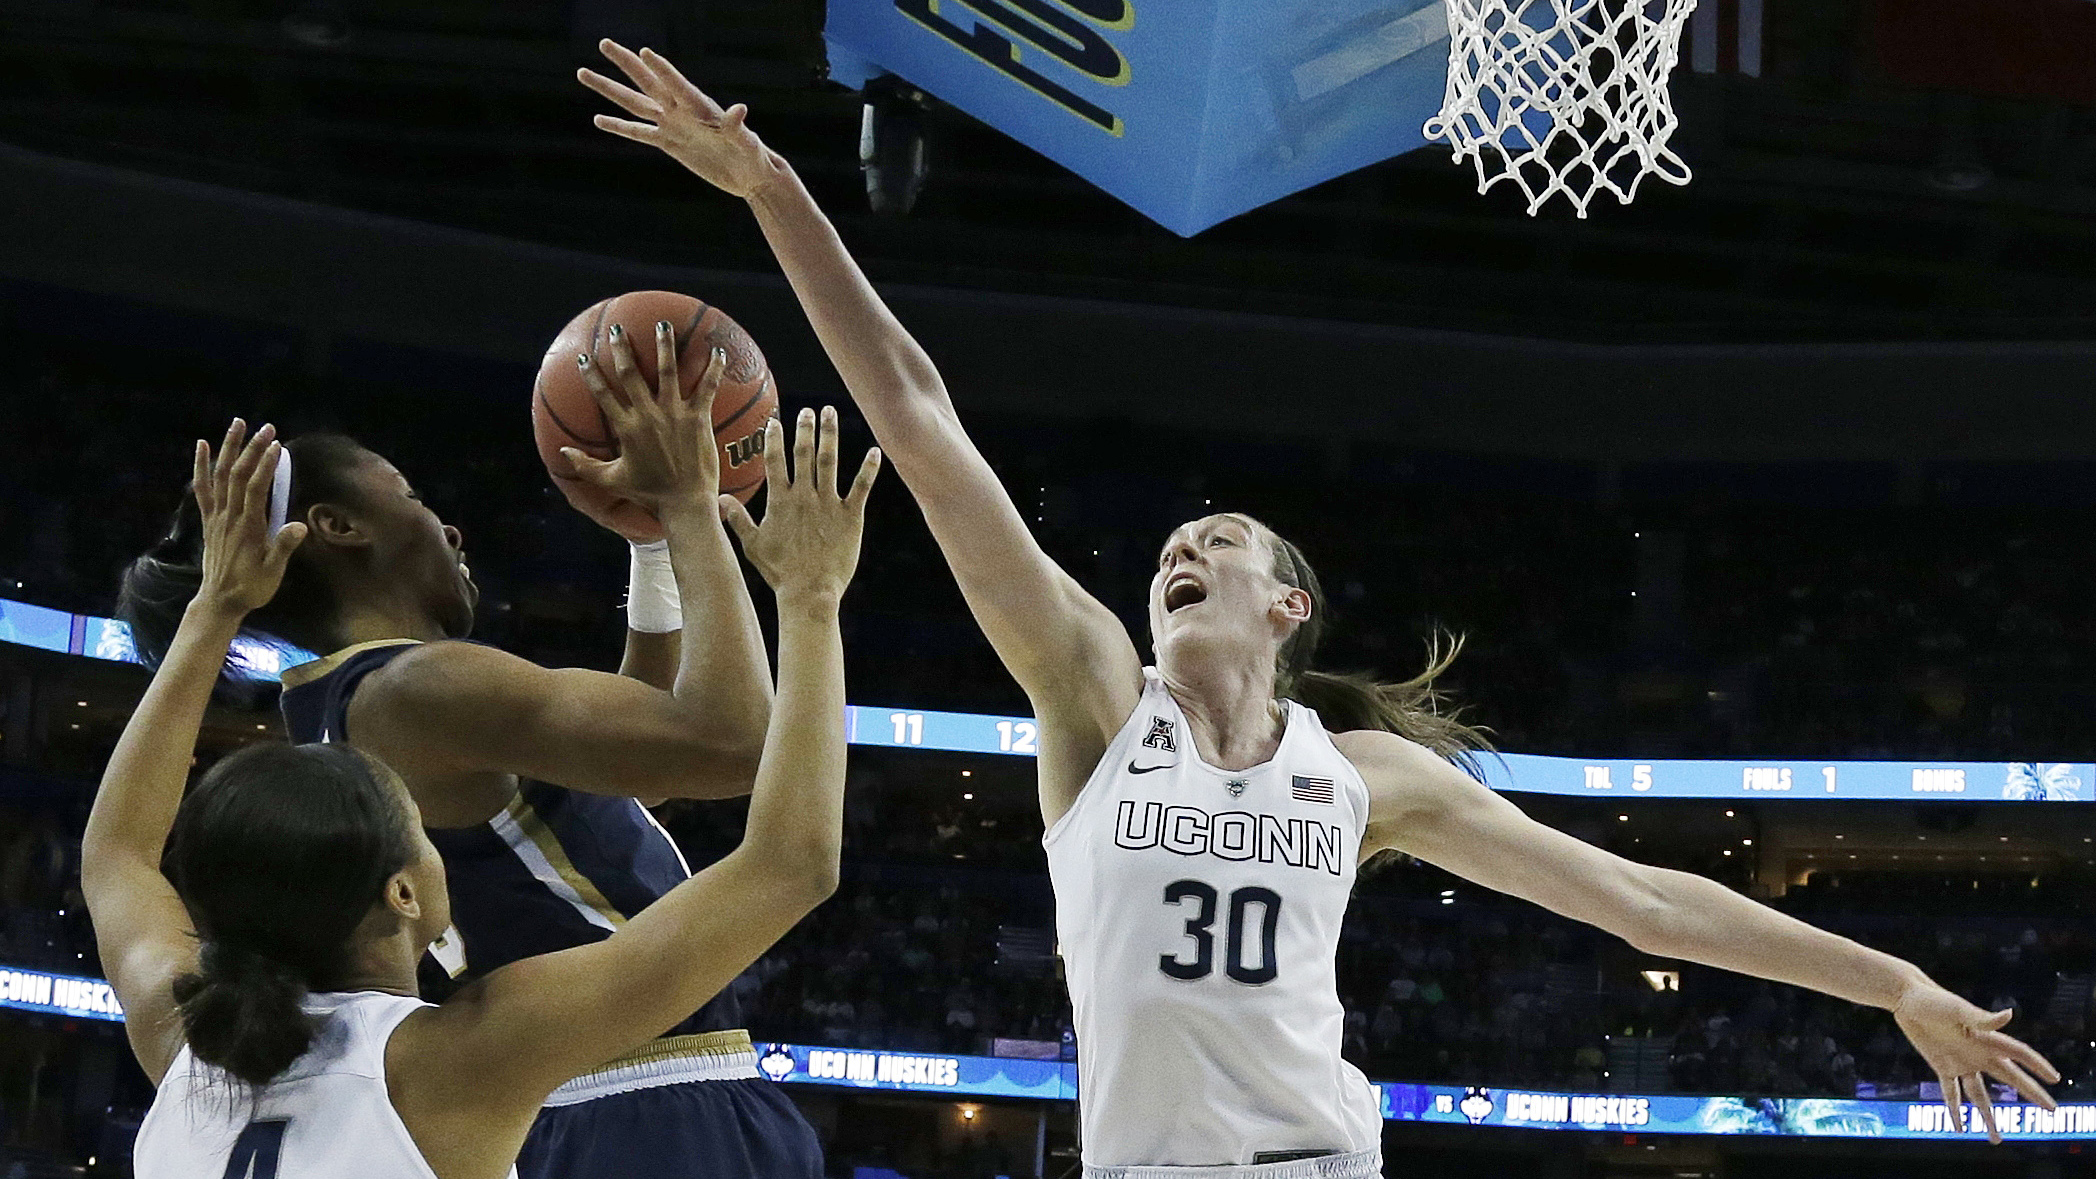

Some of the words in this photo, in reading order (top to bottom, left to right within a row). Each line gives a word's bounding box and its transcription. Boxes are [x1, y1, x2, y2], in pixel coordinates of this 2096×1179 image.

[890, 712, 924, 746] 11
[995, 721, 1037, 753] 12
[1631, 764, 1653, 792] 5
[1742, 767, 1793, 791] FOULS
[1822, 766, 1837, 793] 1
[1912, 768, 1966, 793] BONUS
[1114, 799, 1342, 876] UCONN
[1158, 878, 1284, 987] 30
[808, 1050, 876, 1081] UCONN
[877, 1054, 960, 1087] HUSKIES
[1506, 1092, 1569, 1123] UCONN
[1571, 1096, 1649, 1126] HUSKIES
[1970, 1106, 2022, 1134] DME
